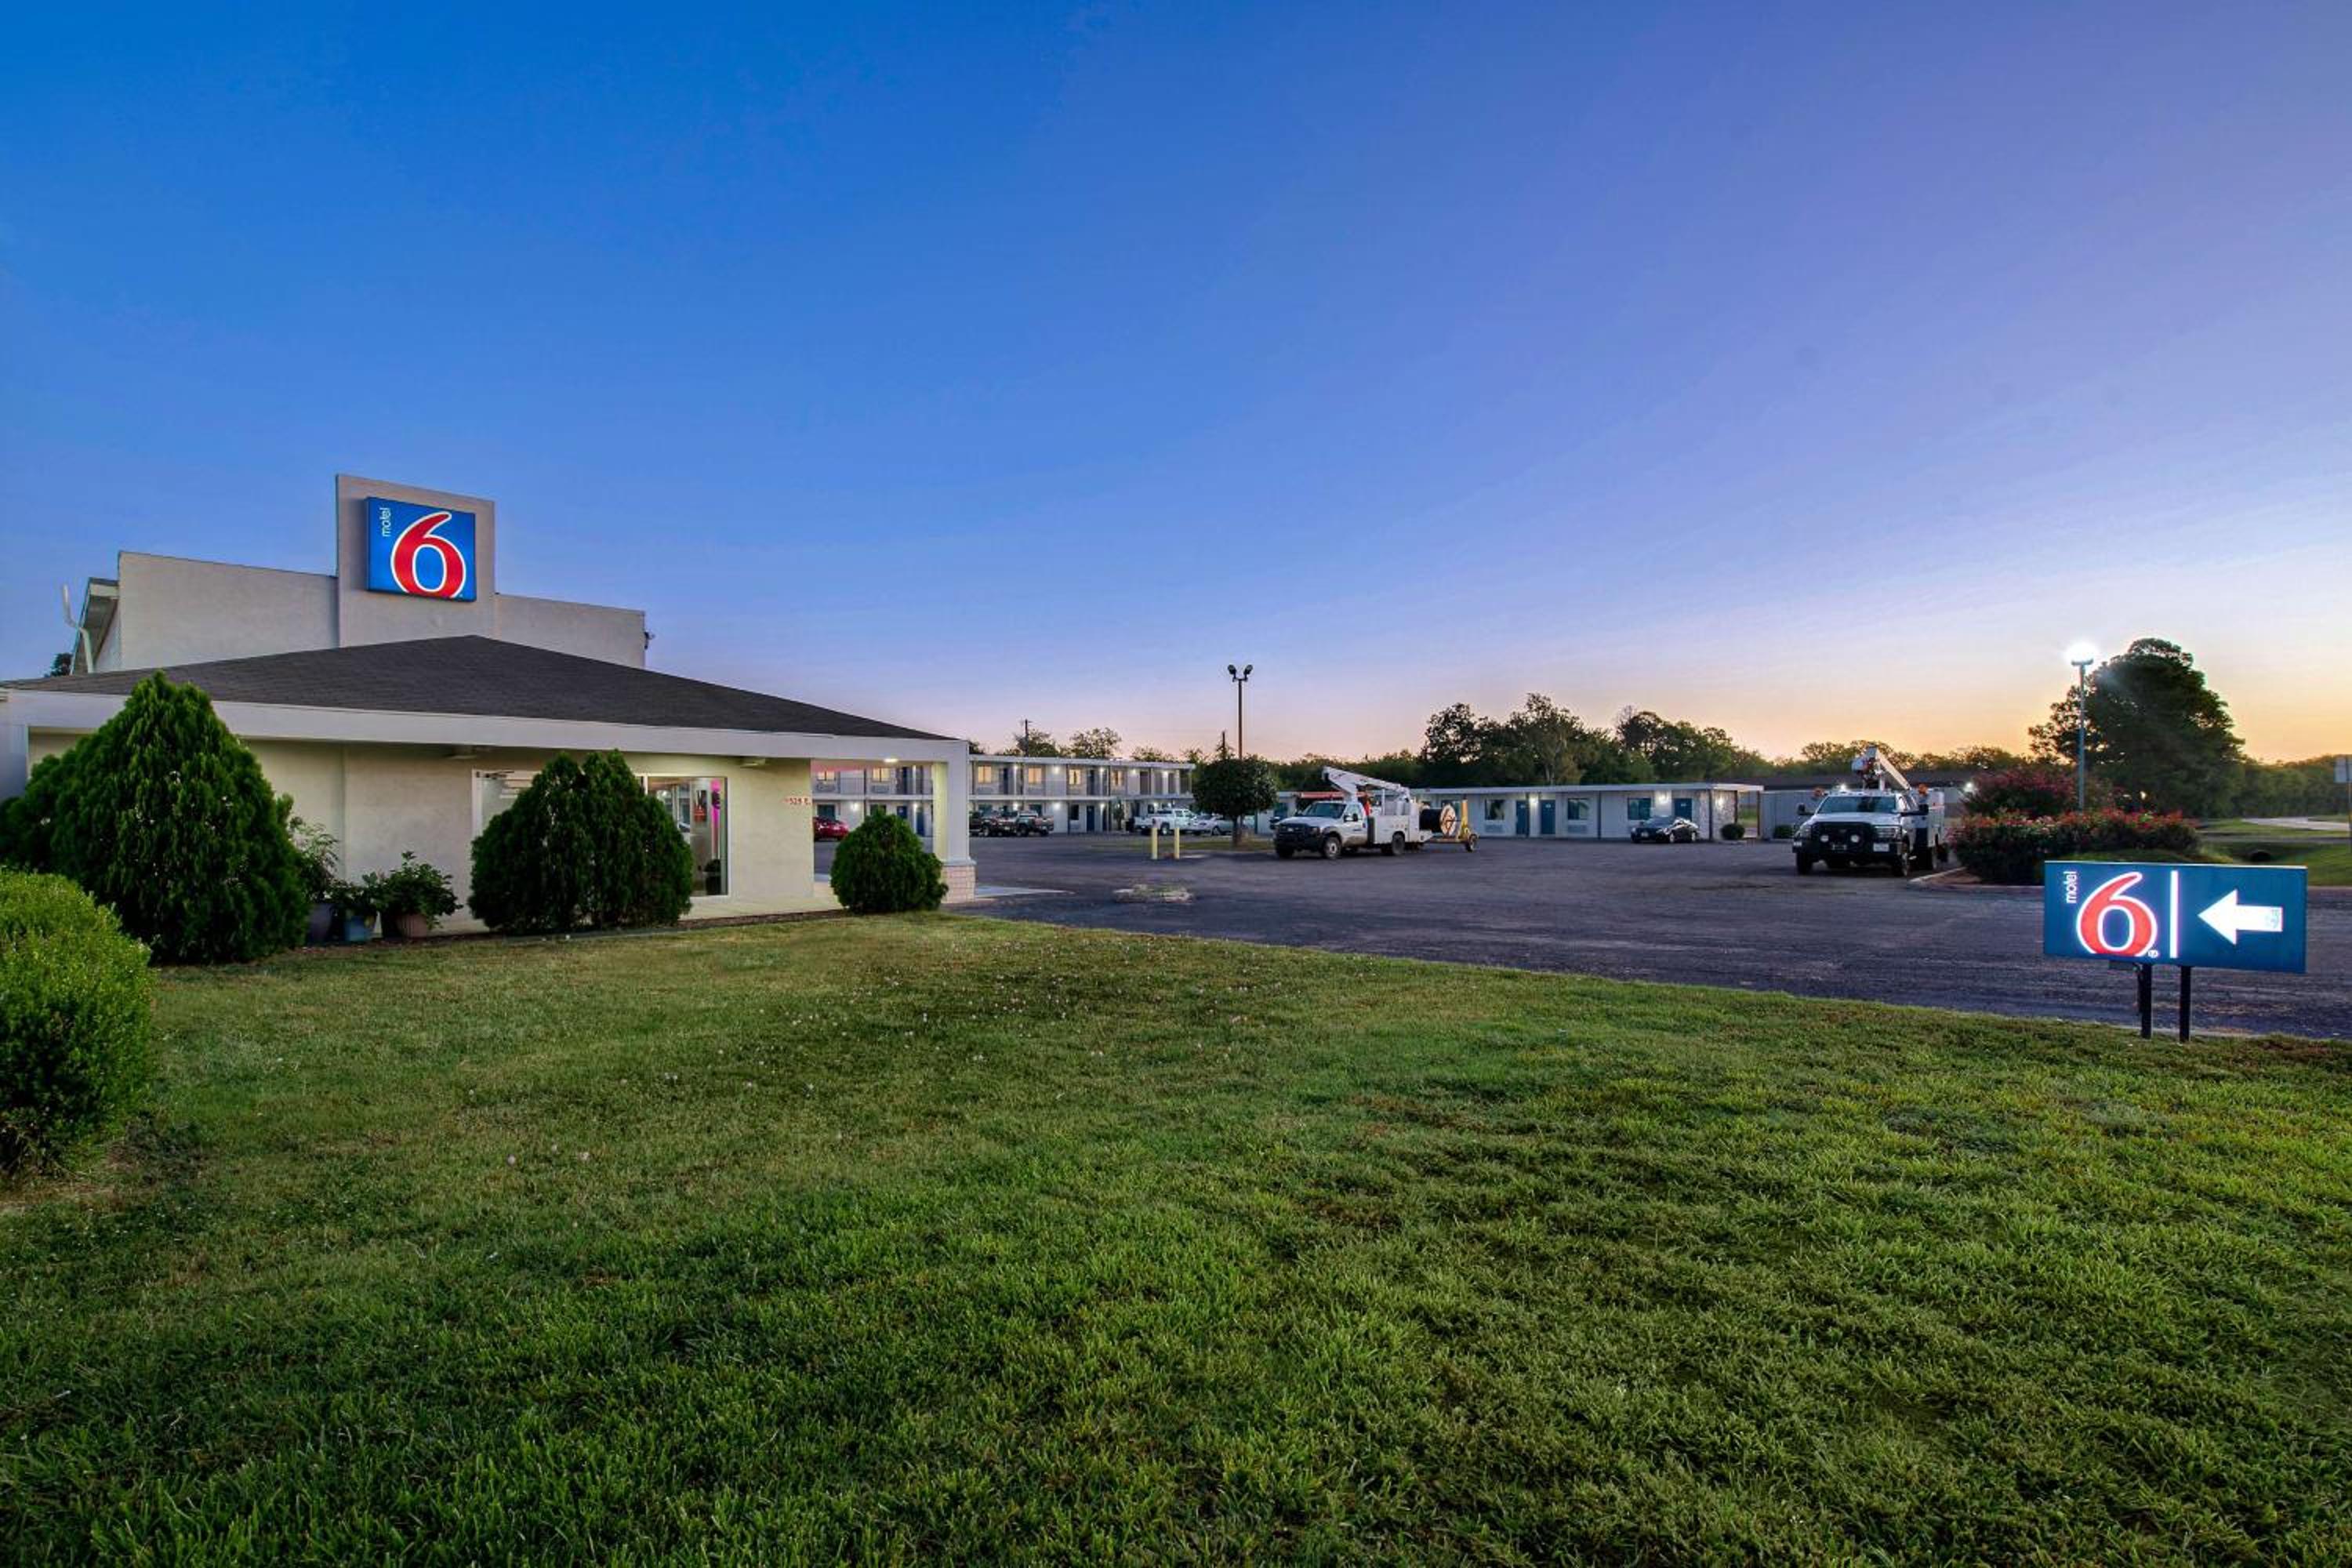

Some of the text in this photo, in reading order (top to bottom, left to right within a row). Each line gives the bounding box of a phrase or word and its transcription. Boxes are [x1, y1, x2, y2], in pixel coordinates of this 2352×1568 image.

[379, 507, 466, 597] motel 6
[2063, 871, 2158, 956] motel 6
